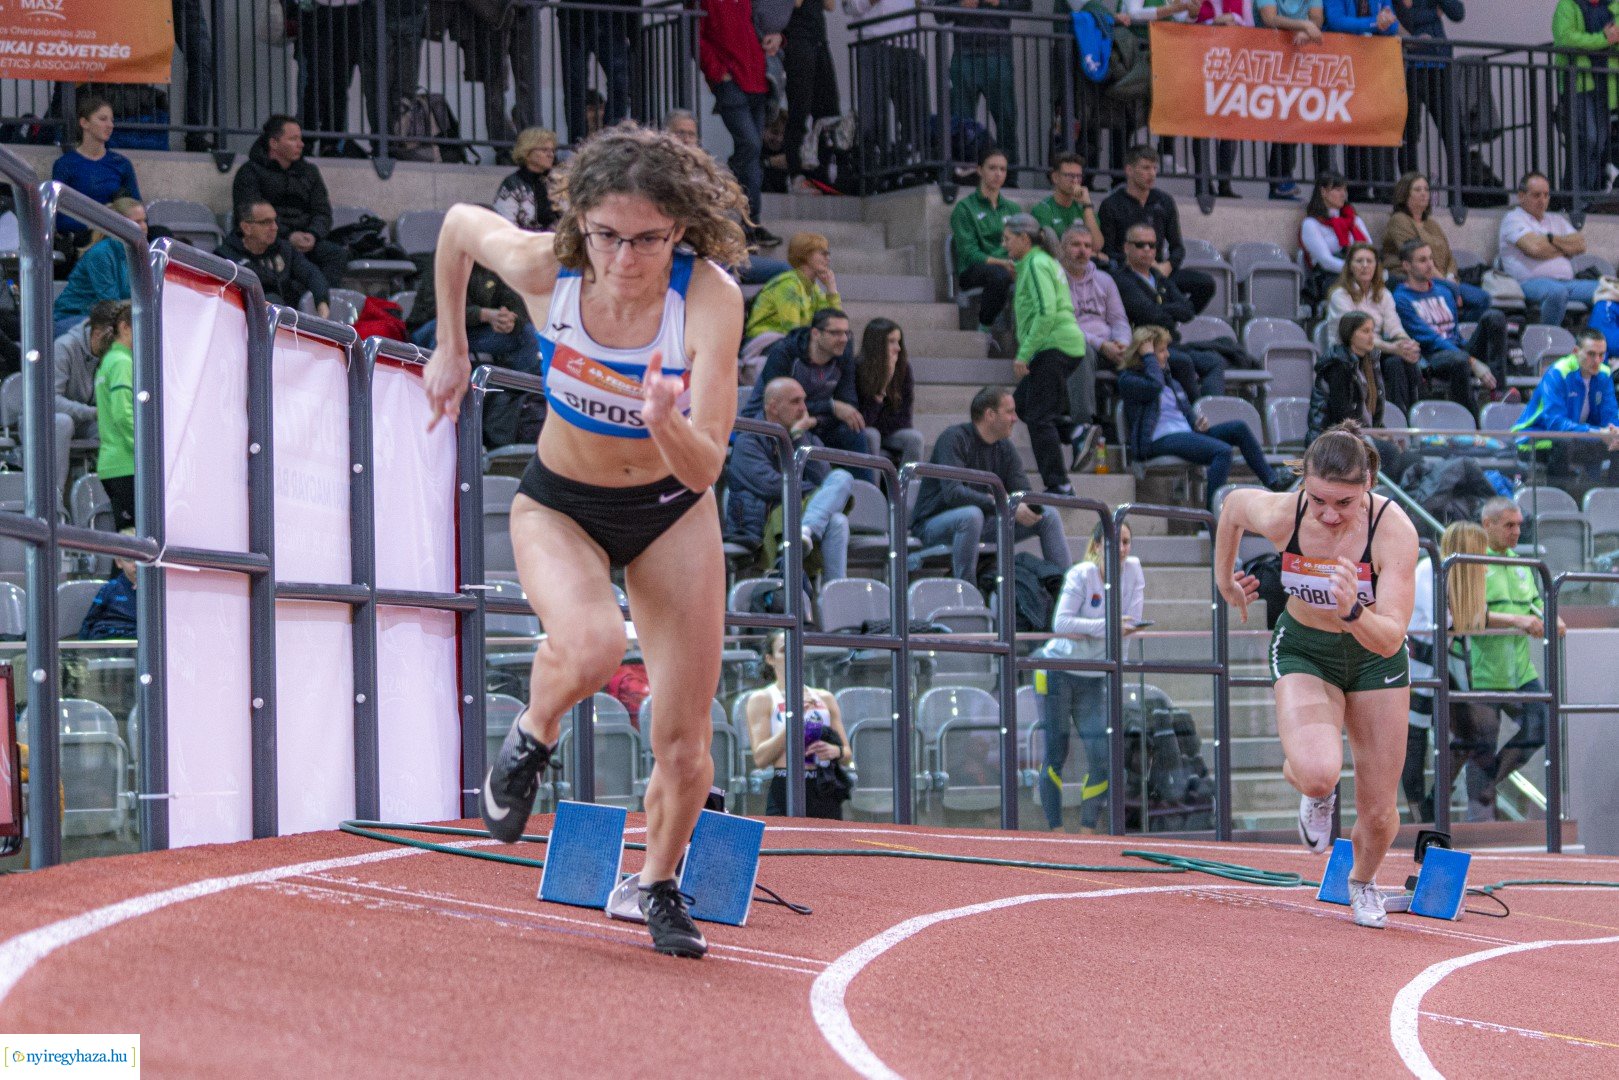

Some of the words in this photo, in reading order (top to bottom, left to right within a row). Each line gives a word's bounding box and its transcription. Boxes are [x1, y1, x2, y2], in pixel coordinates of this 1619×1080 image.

[0, 40, 33, 55] IKAI
[36, 41, 131, 58] SZÖVETSÉG
[32, 59, 107, 72] ASSOCIATION
[1204, 80, 1354, 123] VAGYOK
[1289, 584, 1369, 606] GÖBLS
